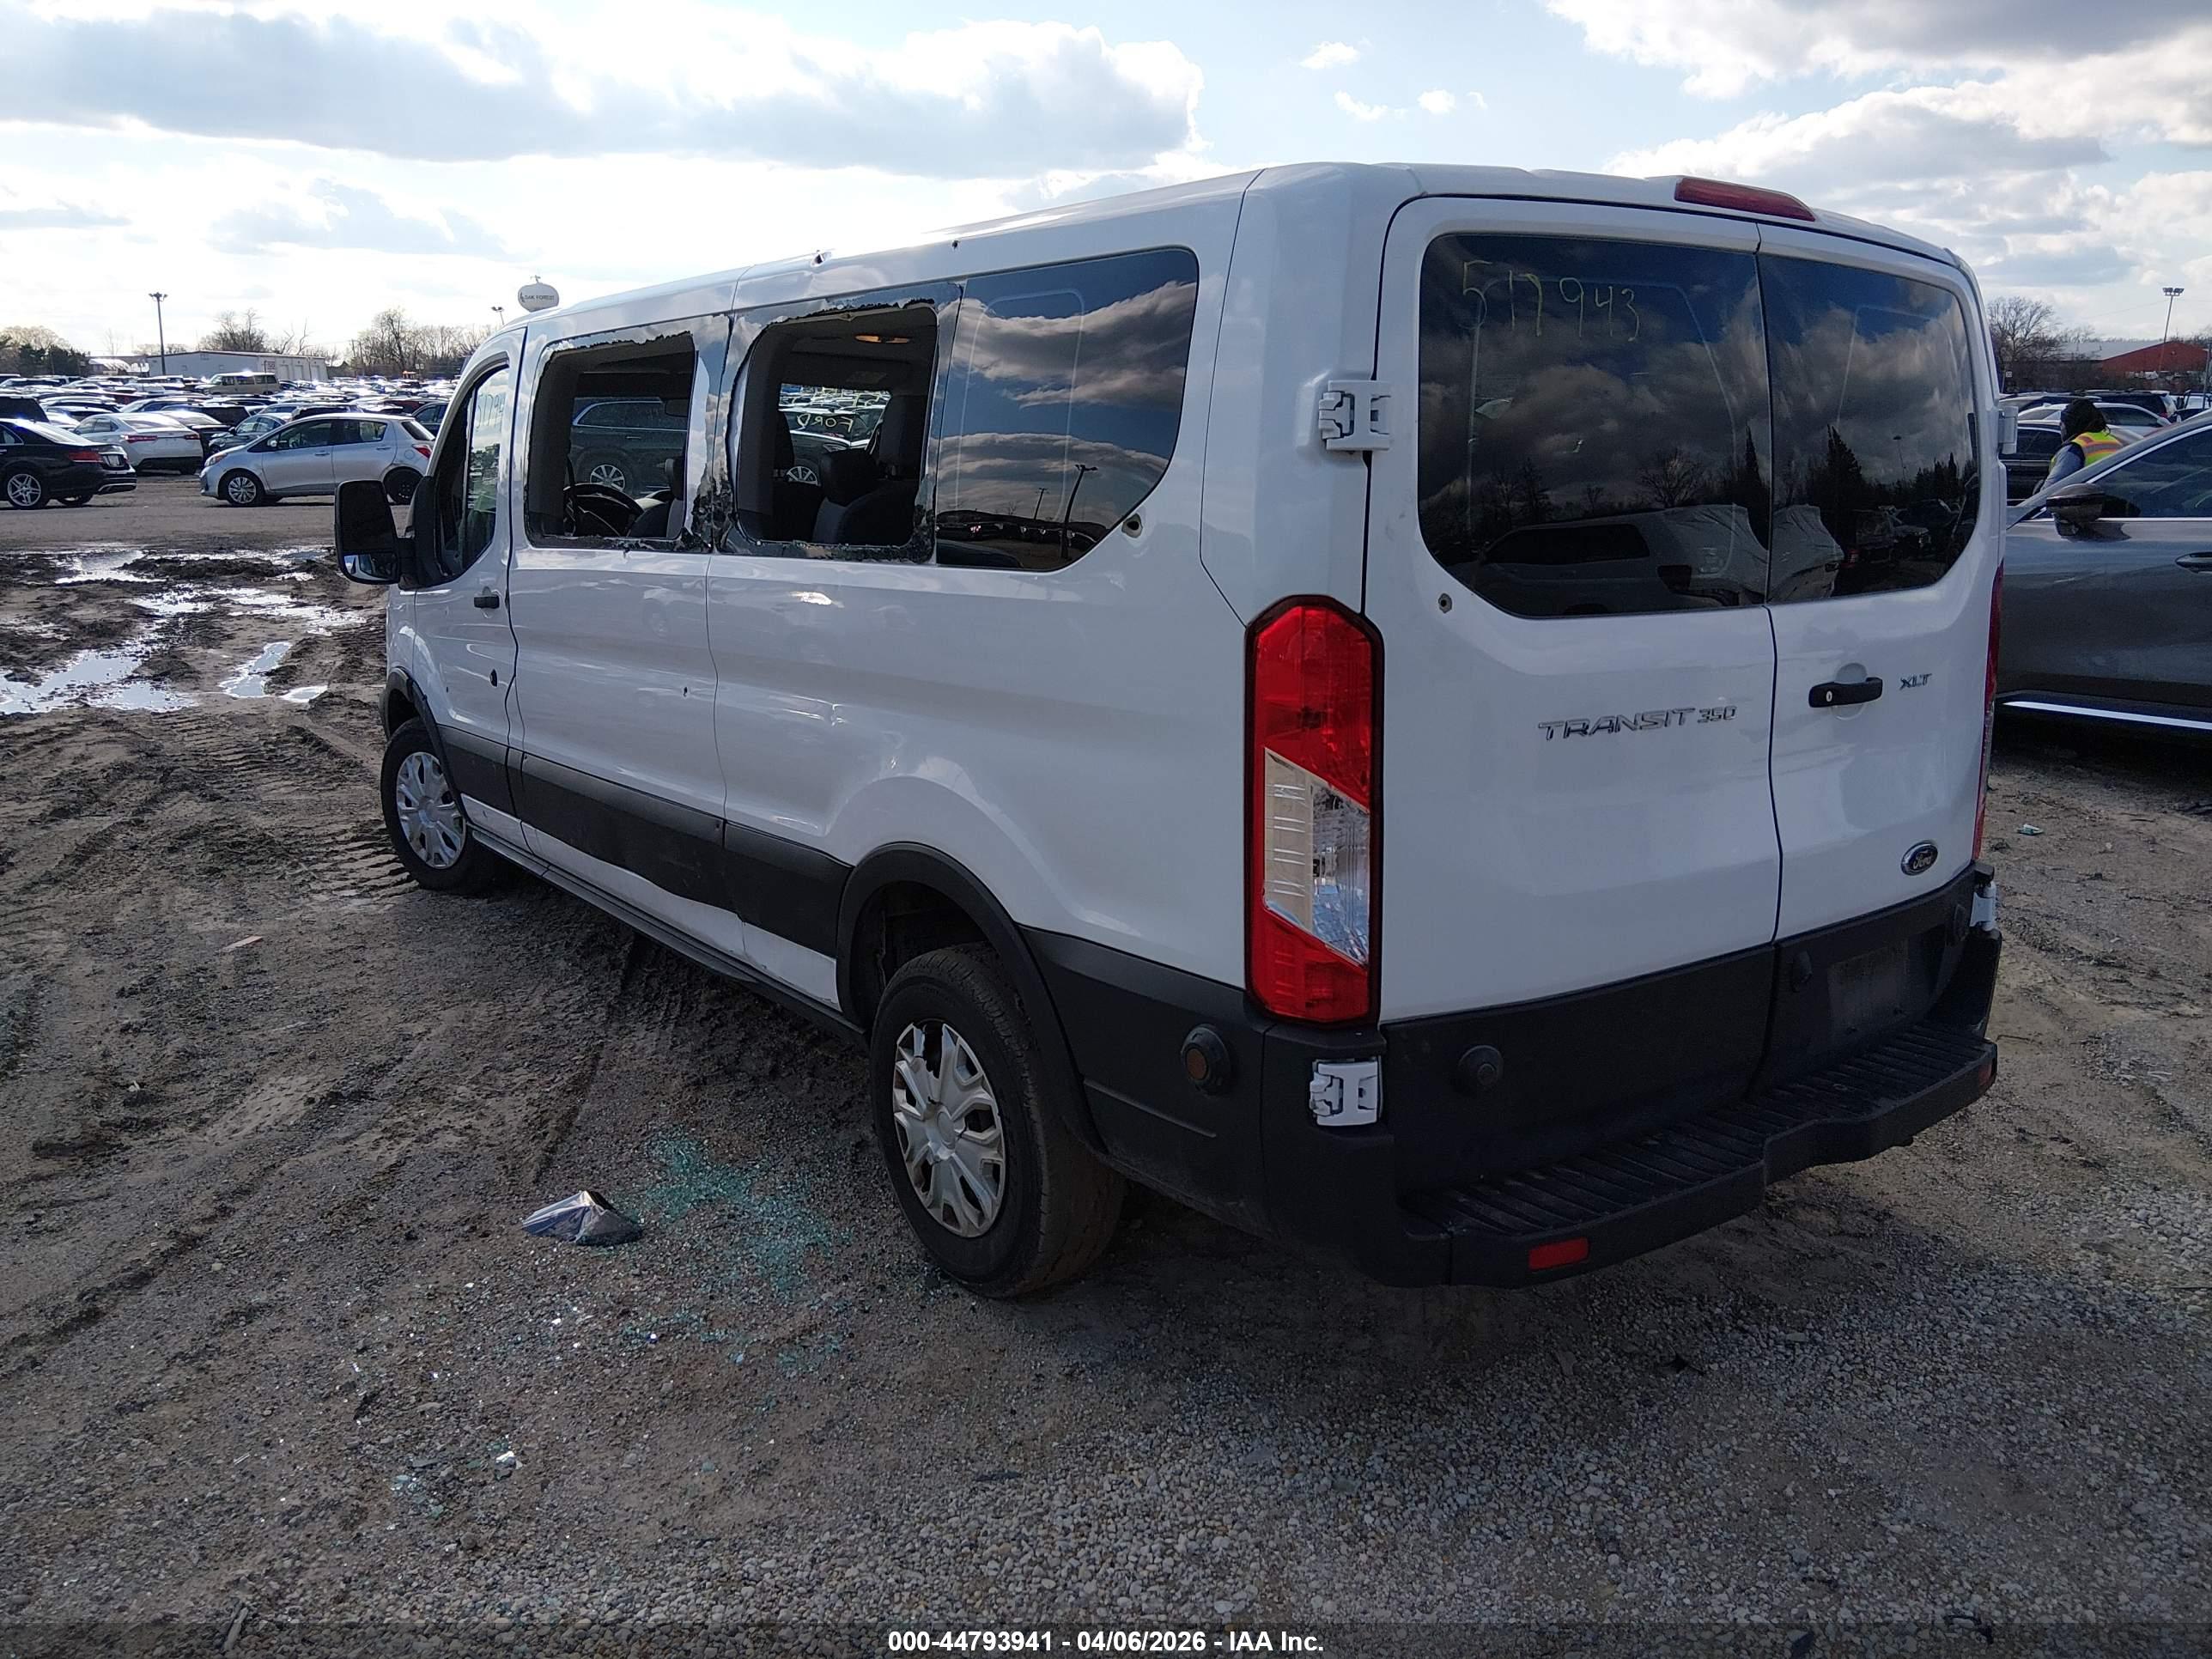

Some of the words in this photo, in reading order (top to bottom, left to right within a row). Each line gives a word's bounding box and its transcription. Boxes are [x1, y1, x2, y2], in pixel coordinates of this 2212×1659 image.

[1459, 259, 1640, 342] 517943
[1899, 673, 1933, 690] XLT
[1539, 708, 1696, 741] TRANSIT
[1698, 705, 1737, 724] 350
